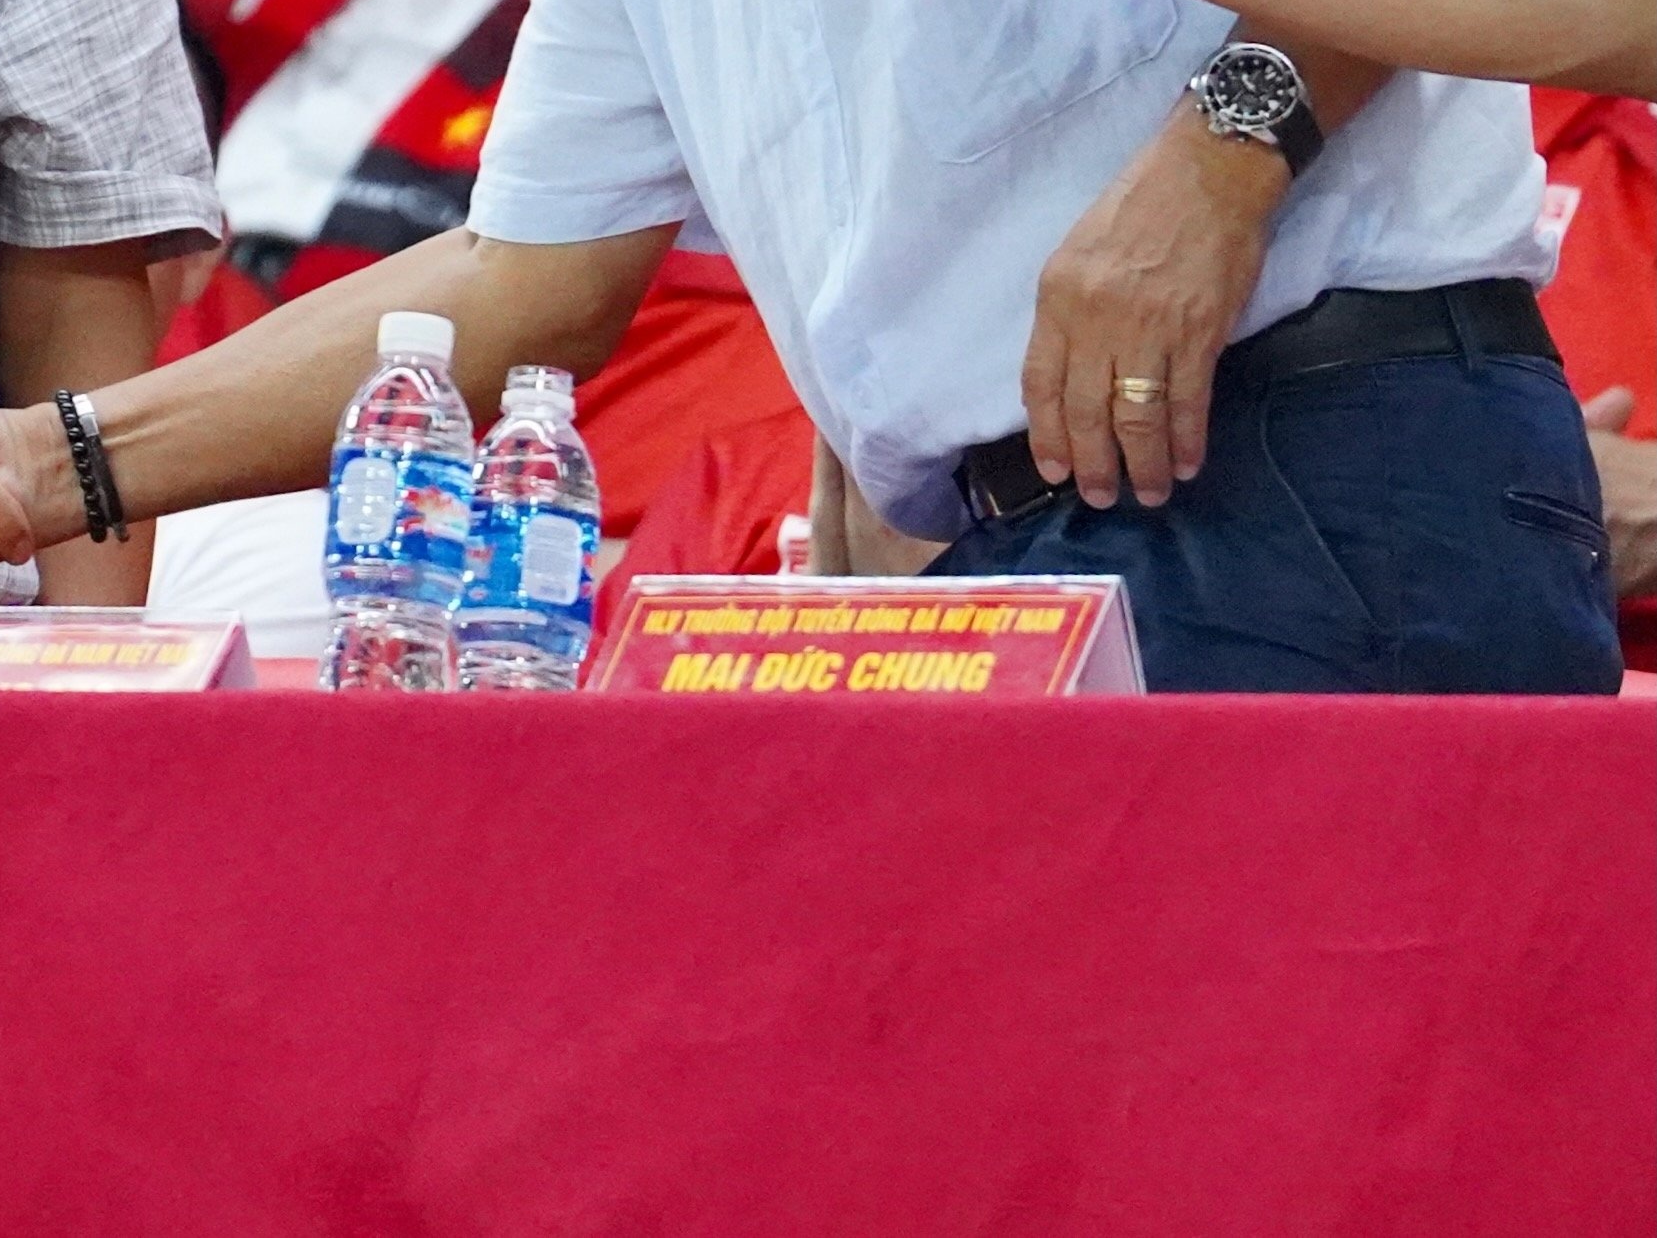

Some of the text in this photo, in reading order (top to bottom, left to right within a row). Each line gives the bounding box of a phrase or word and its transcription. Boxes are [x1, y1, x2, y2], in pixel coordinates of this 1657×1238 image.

[661, 646, 996, 692] MAI ĐỨC CHUNG
